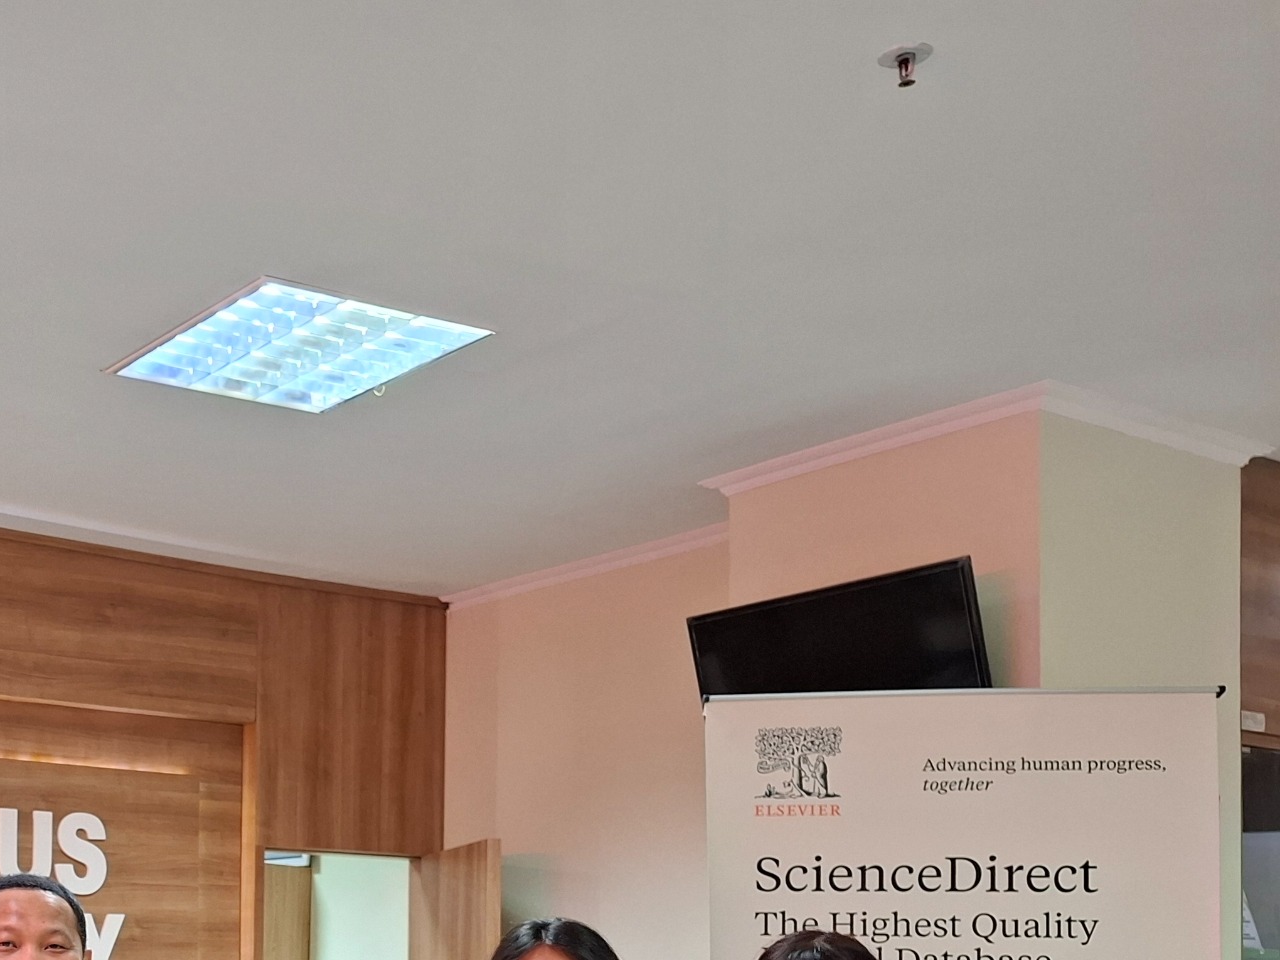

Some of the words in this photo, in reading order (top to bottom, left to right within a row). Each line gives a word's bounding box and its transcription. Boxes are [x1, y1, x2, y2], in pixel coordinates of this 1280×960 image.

[923, 758, 1016, 774] Advancing
[1021, 757, 1082, 771] human
[1087, 758, 1167, 774] progress,
[923, 777, 993, 795] together
[755, 804, 841, 816] ELSEVIER
[755, 855, 1099, 893] ScienceDirect
[754, 910, 819, 936] The
[828, 910, 961, 944] Highest
[971, 912, 1099, 945] Quality
